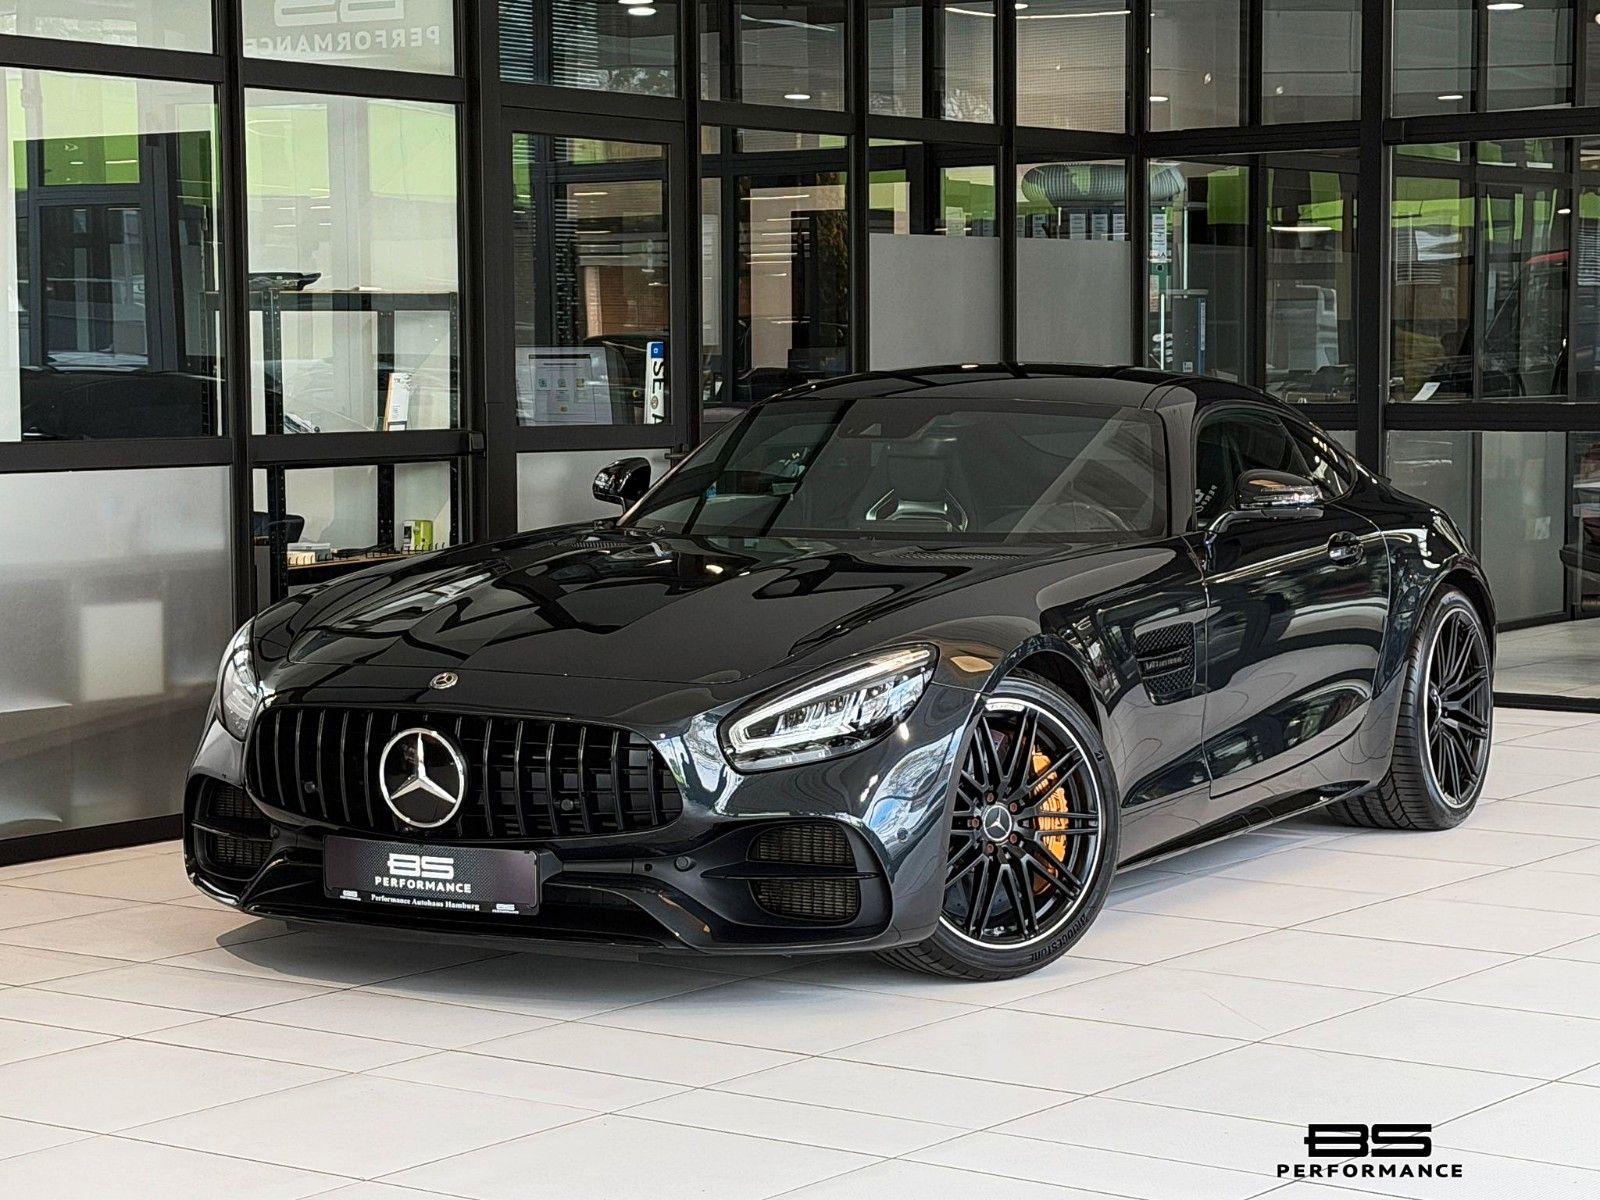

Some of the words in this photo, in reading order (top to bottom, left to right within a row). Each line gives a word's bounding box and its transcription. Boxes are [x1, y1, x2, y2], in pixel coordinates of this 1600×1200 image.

[387, 853, 454, 880] BS
[375, 876, 472, 894] PERFORMANCE
[371, 894, 410, 905] Performance
[412, 898, 444, 908] Autohaus
[445, 901, 480, 911] Hamburg
